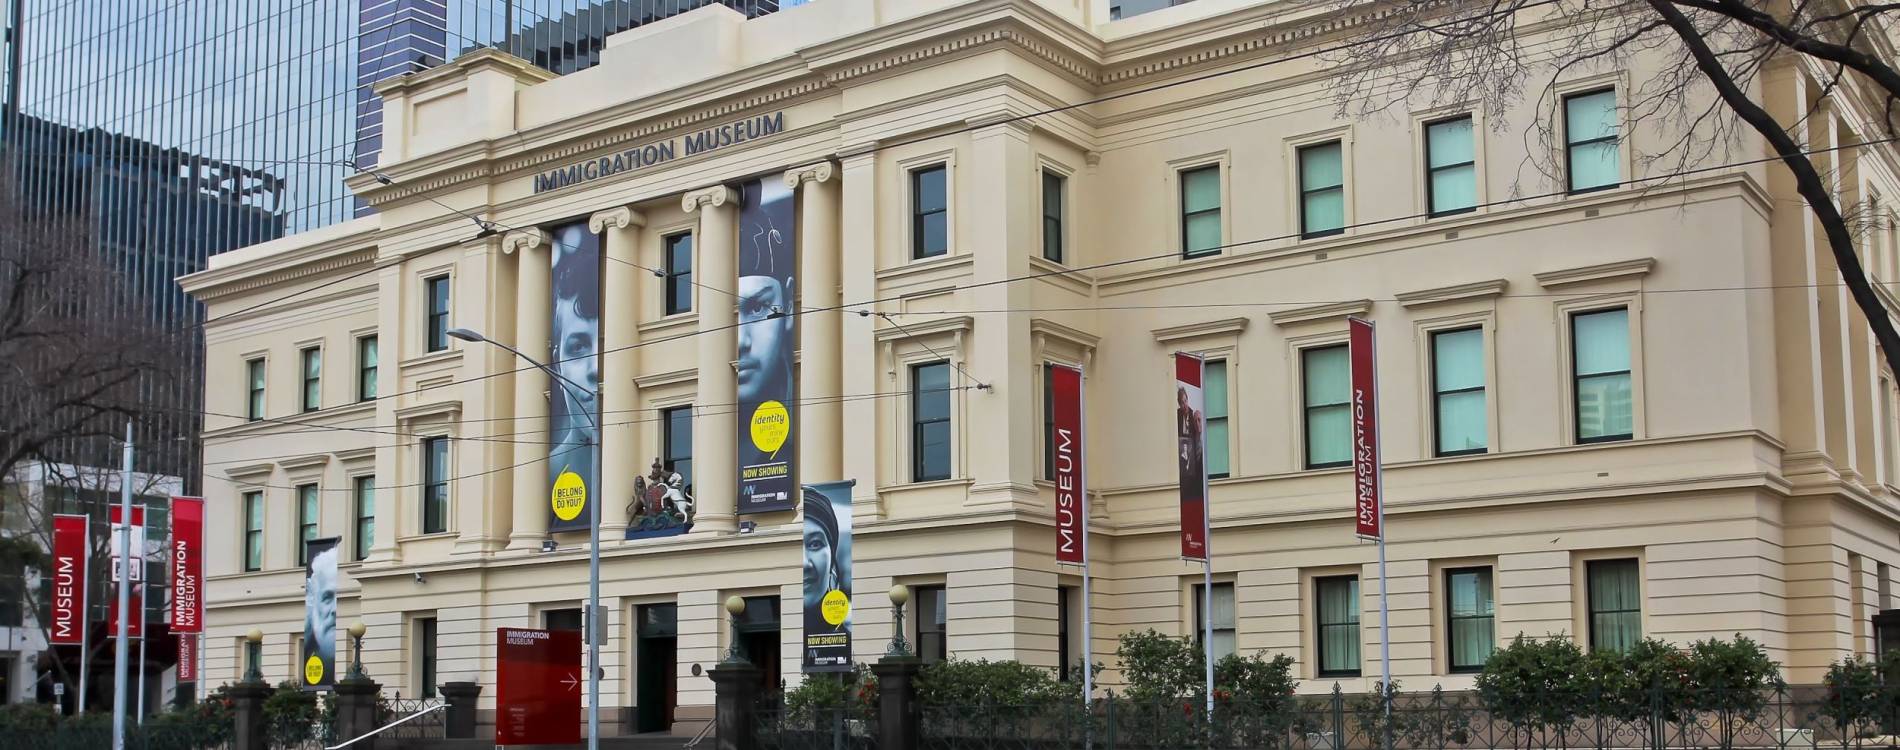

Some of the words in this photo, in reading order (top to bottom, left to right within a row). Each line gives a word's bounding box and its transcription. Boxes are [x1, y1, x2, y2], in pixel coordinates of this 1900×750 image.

[533, 140, 675, 194] IMMIGRATION
[684, 111, 784, 156] MUSEUM
[755, 413, 785, 425] identity
[743, 467, 758, 479] NOW
[758, 464, 788, 477] SHOWING
[1355, 389, 1367, 525] IMMIGRATION
[557, 486, 583, 498] BELONG
[1058, 429, 1073, 552] MUSEUM
[1365, 445, 1374, 526] MUSEUM
[556, 500, 565, 509] DO
[565, 497, 582, 508] YOU?
[56, 556, 73, 637] MUSEUM
[176, 540, 187, 626] IMMIGRATION
[185, 575, 195, 626] MUSEUM
[506, 631, 550, 640] IMMIGRATION
[506, 638, 534, 646] MUSEUM
[807, 637, 820, 646] NOW
[821, 636, 847, 645] SHOWING
